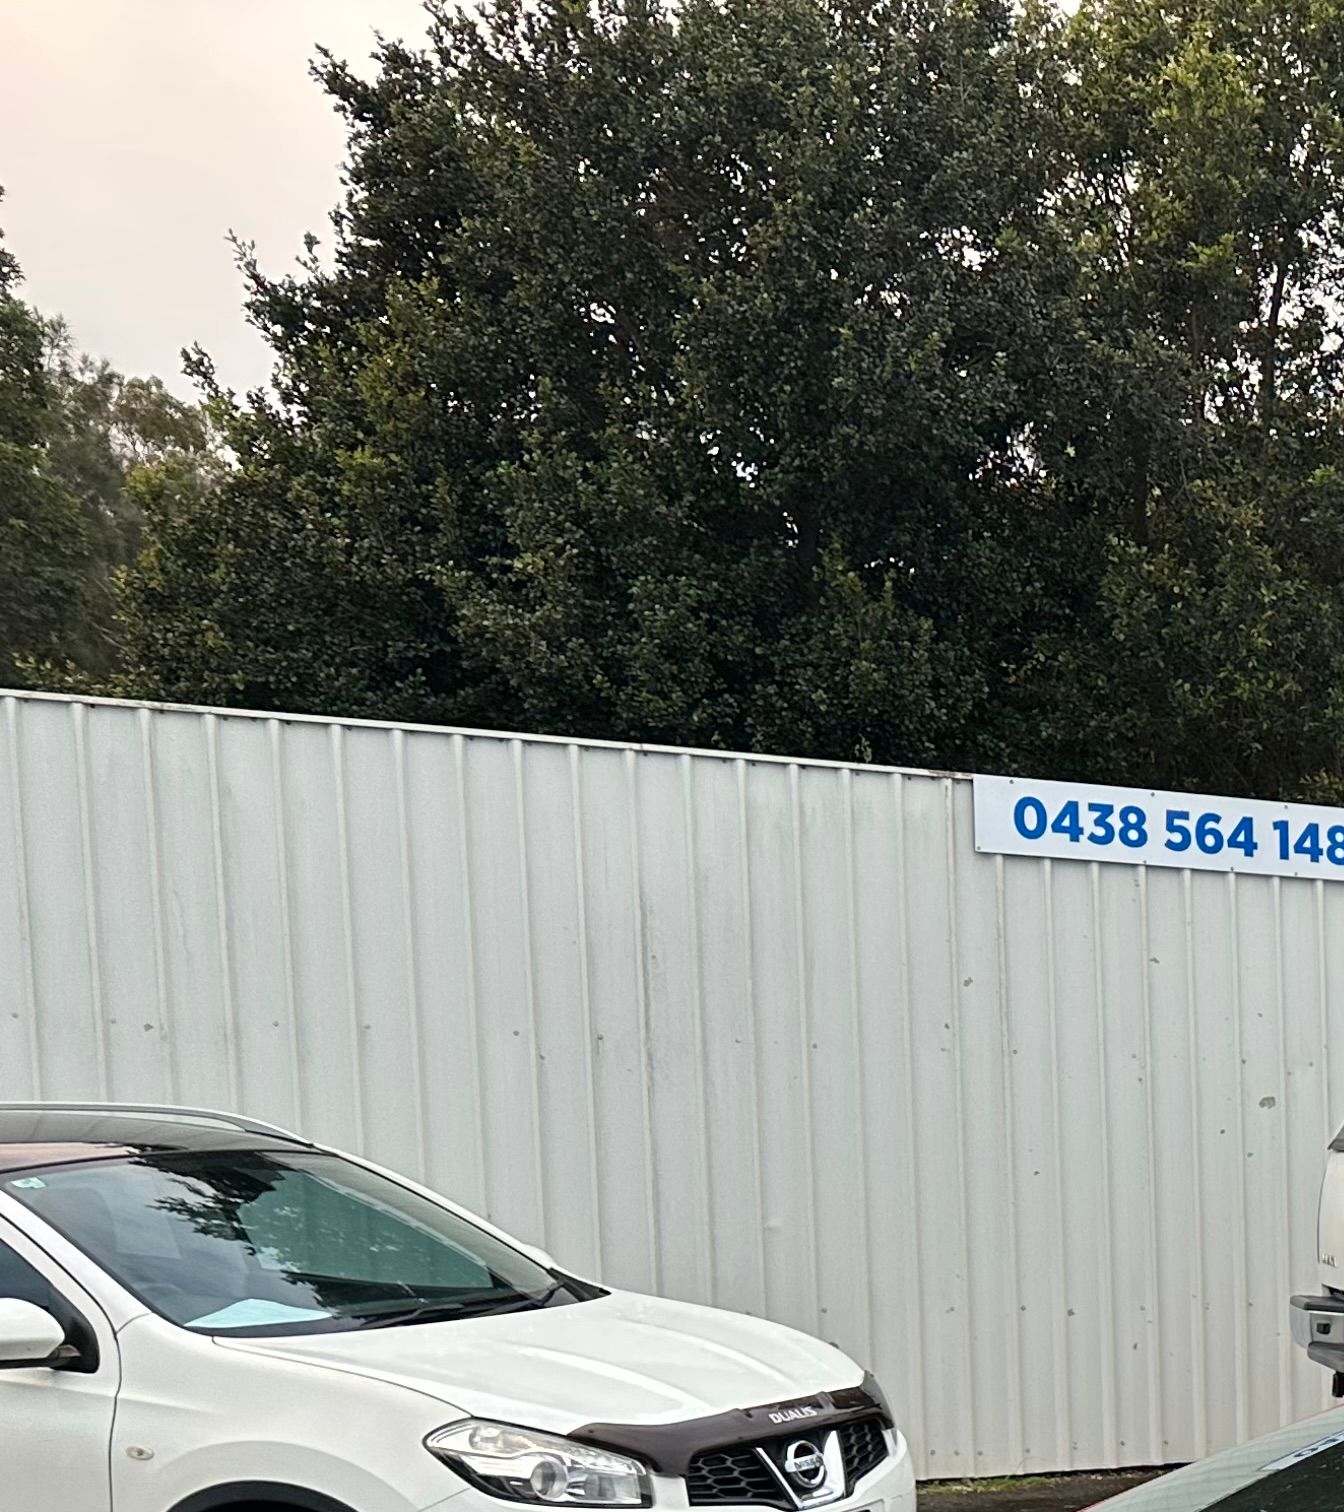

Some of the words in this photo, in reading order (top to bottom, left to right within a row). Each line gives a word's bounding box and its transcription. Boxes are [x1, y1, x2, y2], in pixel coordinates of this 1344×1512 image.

[1012, 795, 1149, 849] 0438
[1164, 809, 1260, 859] 564
[769, 1407, 817, 1424] DUALIS
